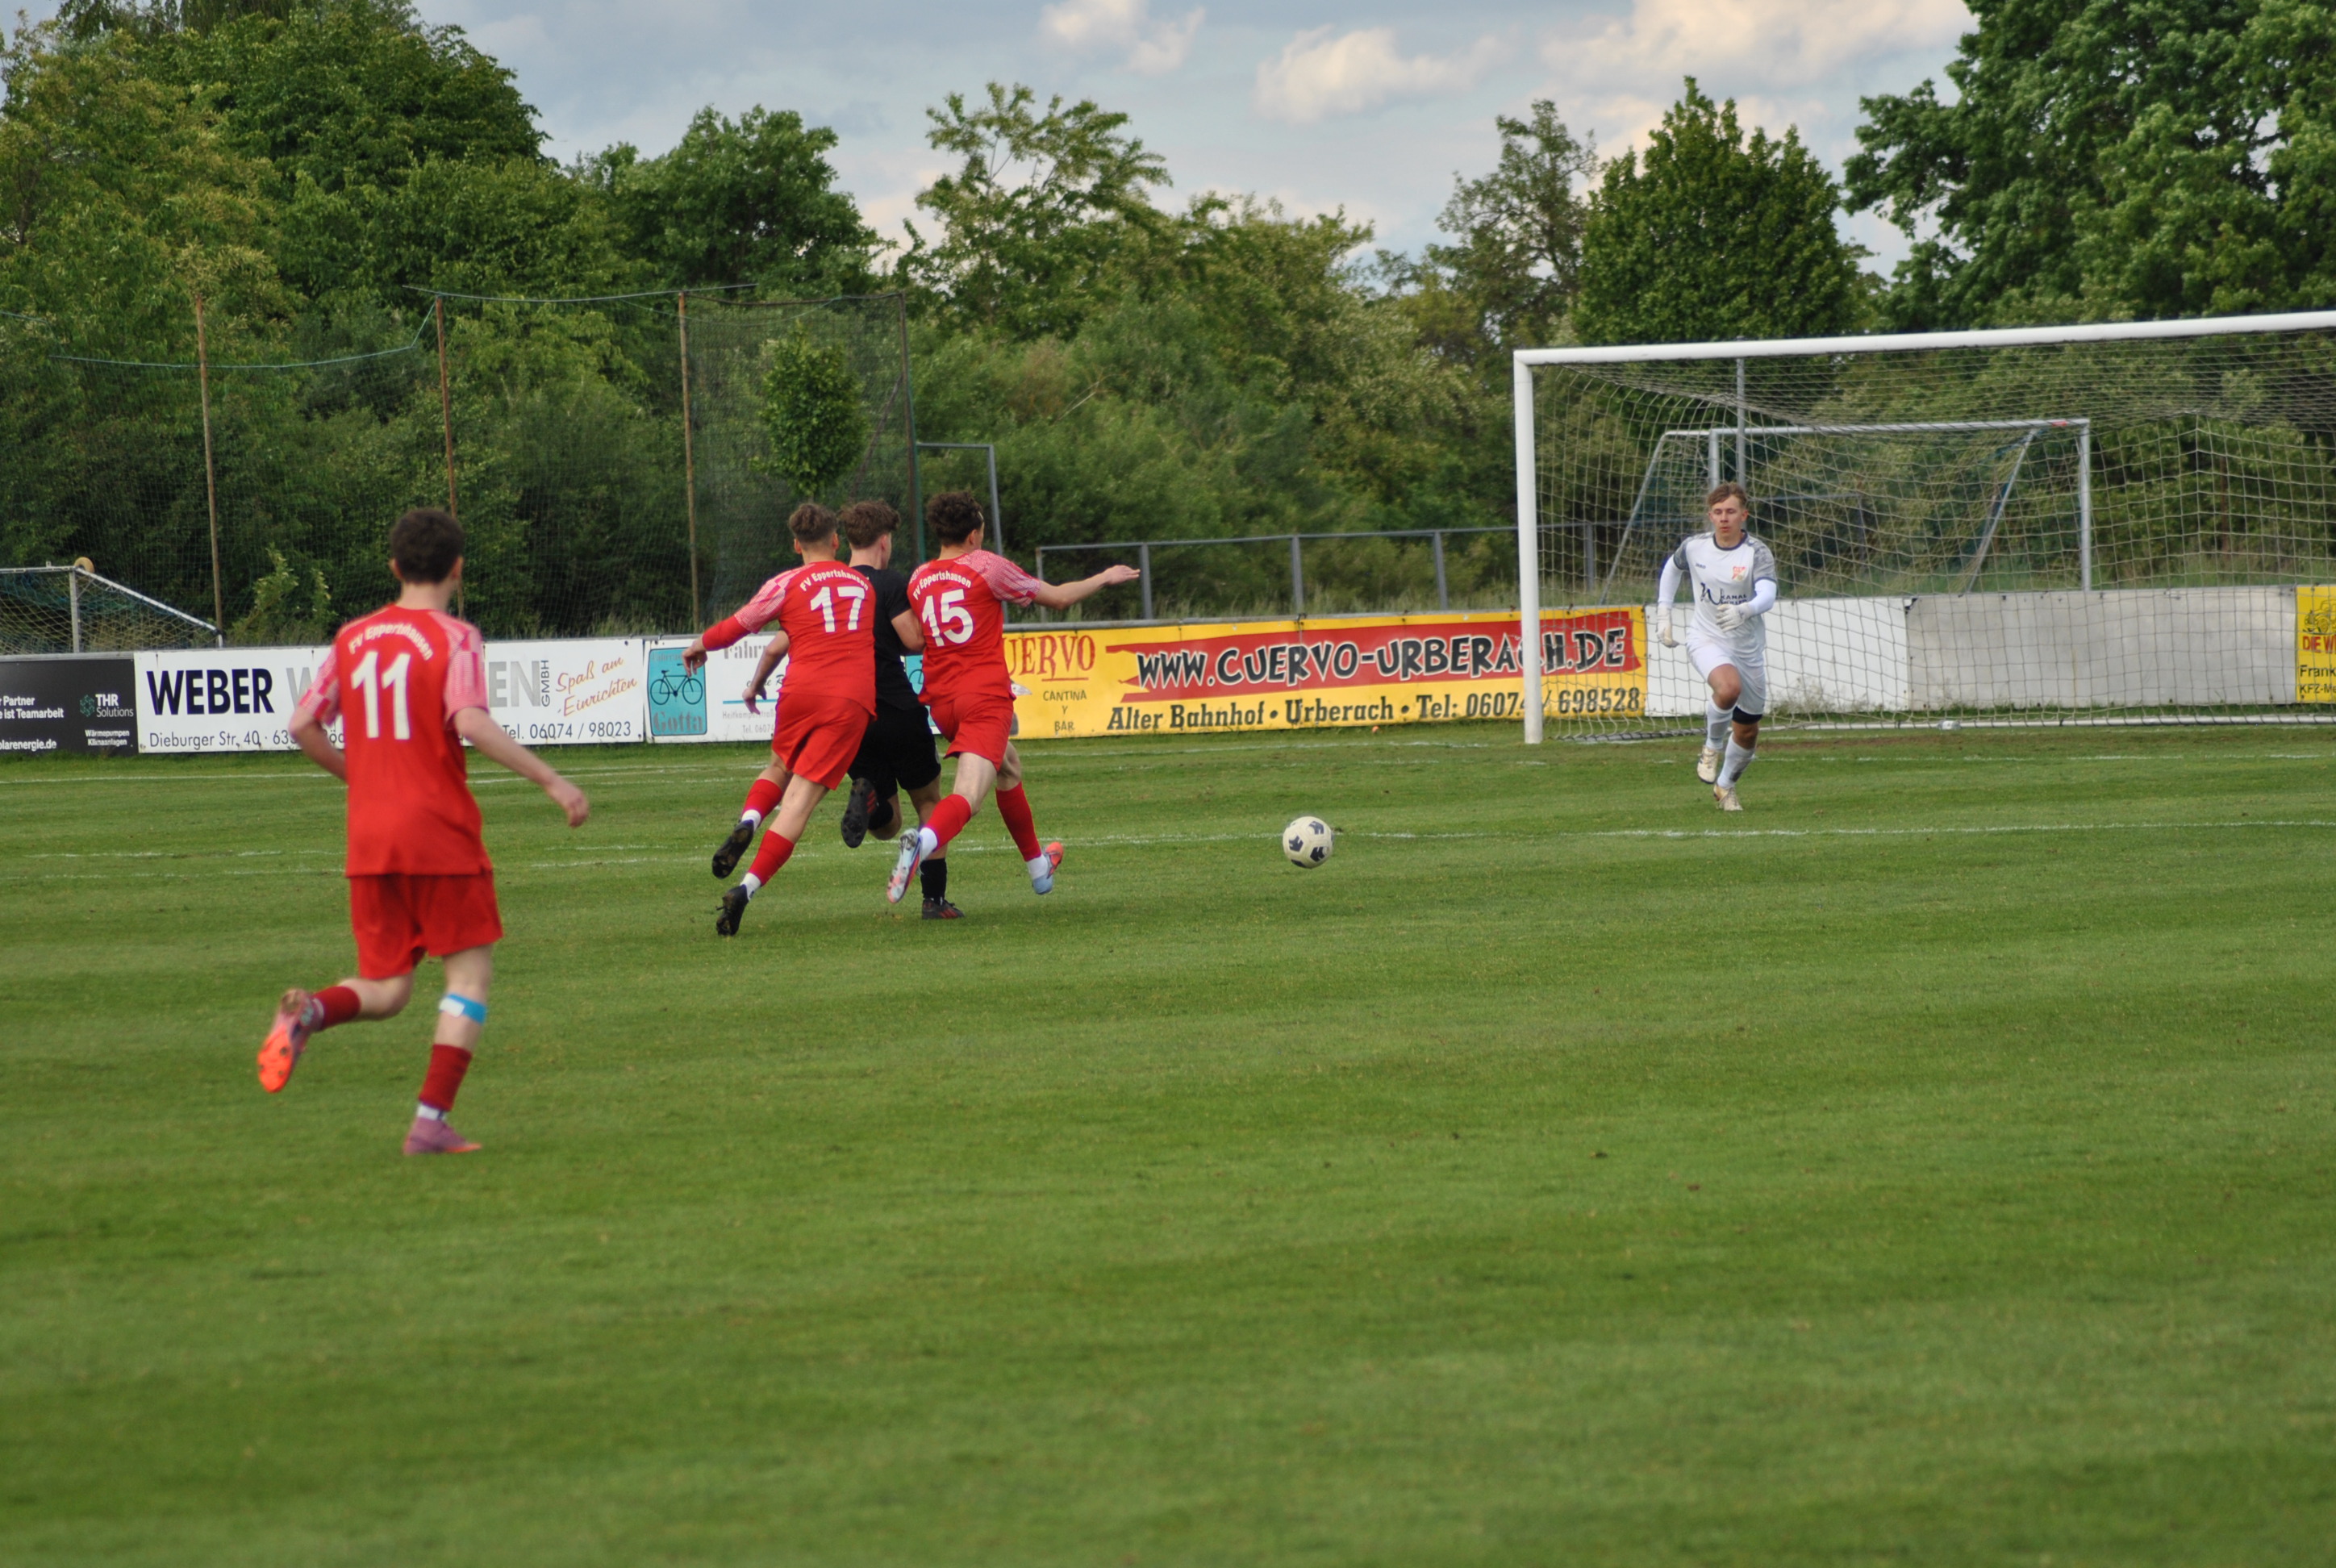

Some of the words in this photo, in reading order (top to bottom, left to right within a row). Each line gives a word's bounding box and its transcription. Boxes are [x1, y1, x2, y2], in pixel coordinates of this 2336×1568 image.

[799, 577, 811, 591] FV
[920, 569, 971, 589] Eppertshausen
[810, 586, 865, 632] 17
[922, 588, 973, 647] 15
[2302, 636, 2321, 653] DIE
[1137, 627, 1627, 690] WWW.CUERVO-URBERAH.DE
[540, 659, 550, 707] GMBH
[555, 660, 594, 694] Spaß
[602, 657, 624, 673] am
[3, 695, 35, 706] Partner
[95, 694, 119, 707] THR
[146, 668, 275, 715] WEBER
[351, 650, 411, 740] 11
[557, 678, 637, 716] Einrichten
[1043, 690, 1087, 702] CANTINA
[4, 708, 15, 719] ist
[16, 707, 64, 719] Teamarbeit
[96, 707, 134, 717] Solutions
[1062, 705, 1068, 715] Y
[1107, 706, 1163, 731] Alter
[1170, 701, 1265, 728] Bahnhof
[1285, 695, 1394, 723] Urberach
[1416, 694, 1458, 719] Tel:
[1558, 687, 1640, 714] 698528
[530, 724, 573, 739] 06074
[589, 721, 631, 737] 98023
[1054, 720, 1075, 732] BAR
[150, 731, 215, 750] Dieburger
[244, 730, 260, 745] 40
